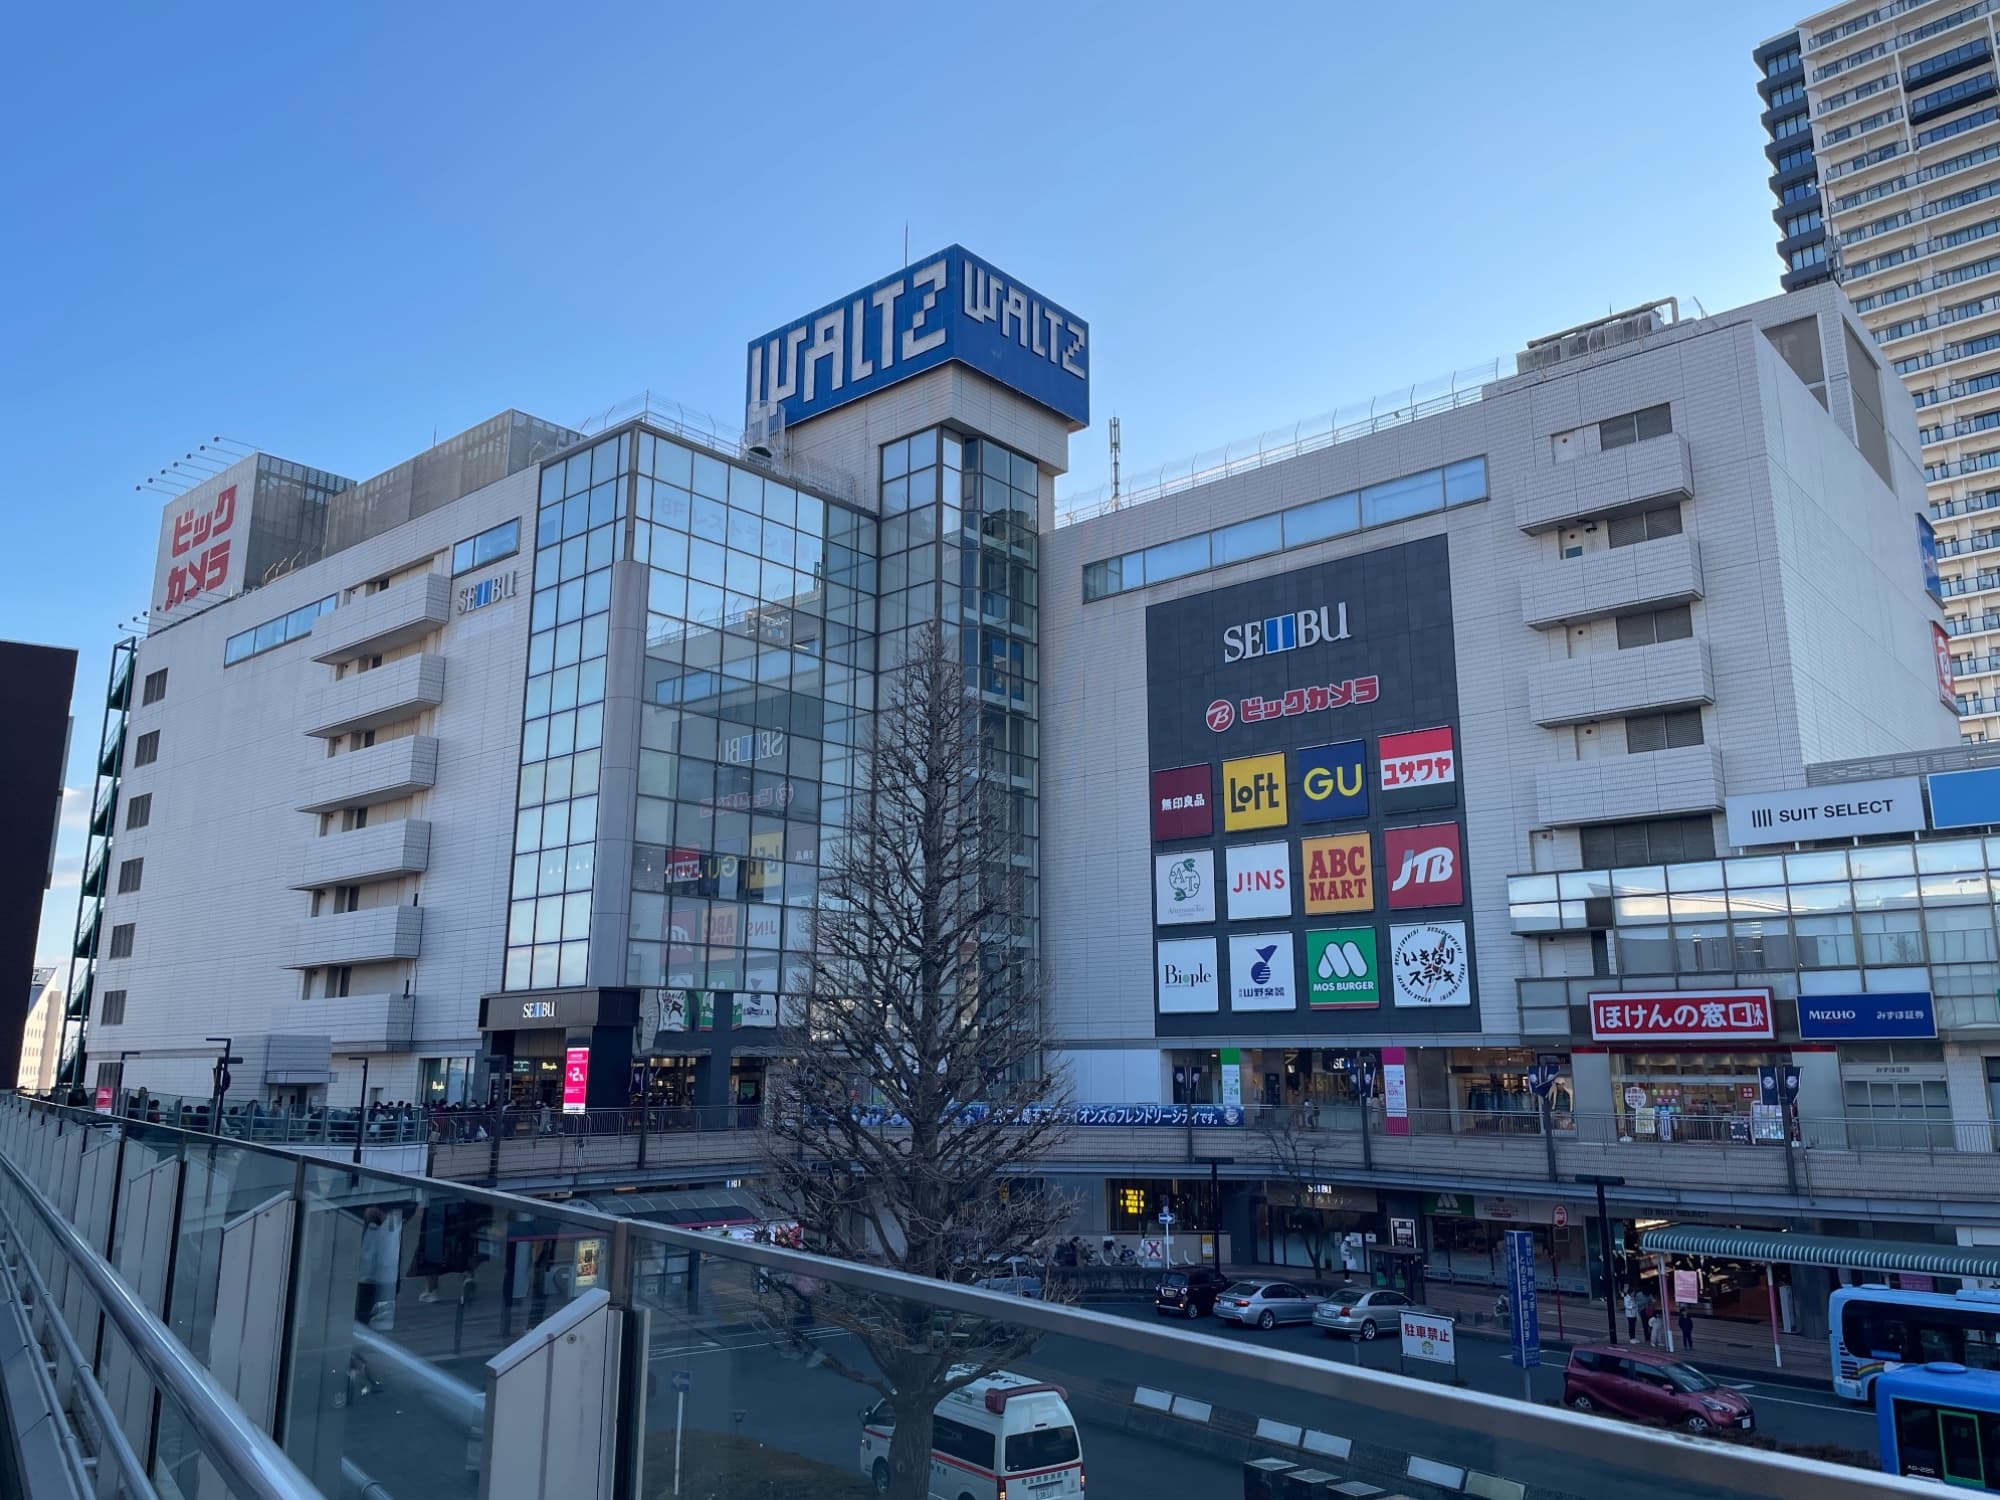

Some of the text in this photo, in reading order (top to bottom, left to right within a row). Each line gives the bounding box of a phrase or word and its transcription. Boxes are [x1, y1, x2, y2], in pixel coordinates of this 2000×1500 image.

[964, 260, 1086, 379] WALTZ
[752, 259, 947, 416] WALTZ
[171, 484, 238, 559] ビック
[164, 539, 232, 611] カメラ
[457, 570, 517, 617] SEIBU
[1223, 601, 1351, 663] SEIBU
[1240, 674, 1379, 724] ビックカメラ
[1303, 763, 1363, 801] GU
[1161, 793, 1205, 811] 無印良品
[1779, 799, 1894, 823] SUIT SELECT
[1308, 846, 1366, 879] ABC
[1391, 846, 1454, 892] JTB
[1309, 878, 1367, 902] MART
[1402, 947, 1455, 966] いきなり
[1313, 980, 1375, 991] MOS BURGER
[1409, 968, 1456, 987] ステーキ
[522, 1001, 555, 1018] SEIBU
[1809, 1009, 1856, 1020] MIZUHO
[1405, 1323, 1450, 1343] 駐車禁止
